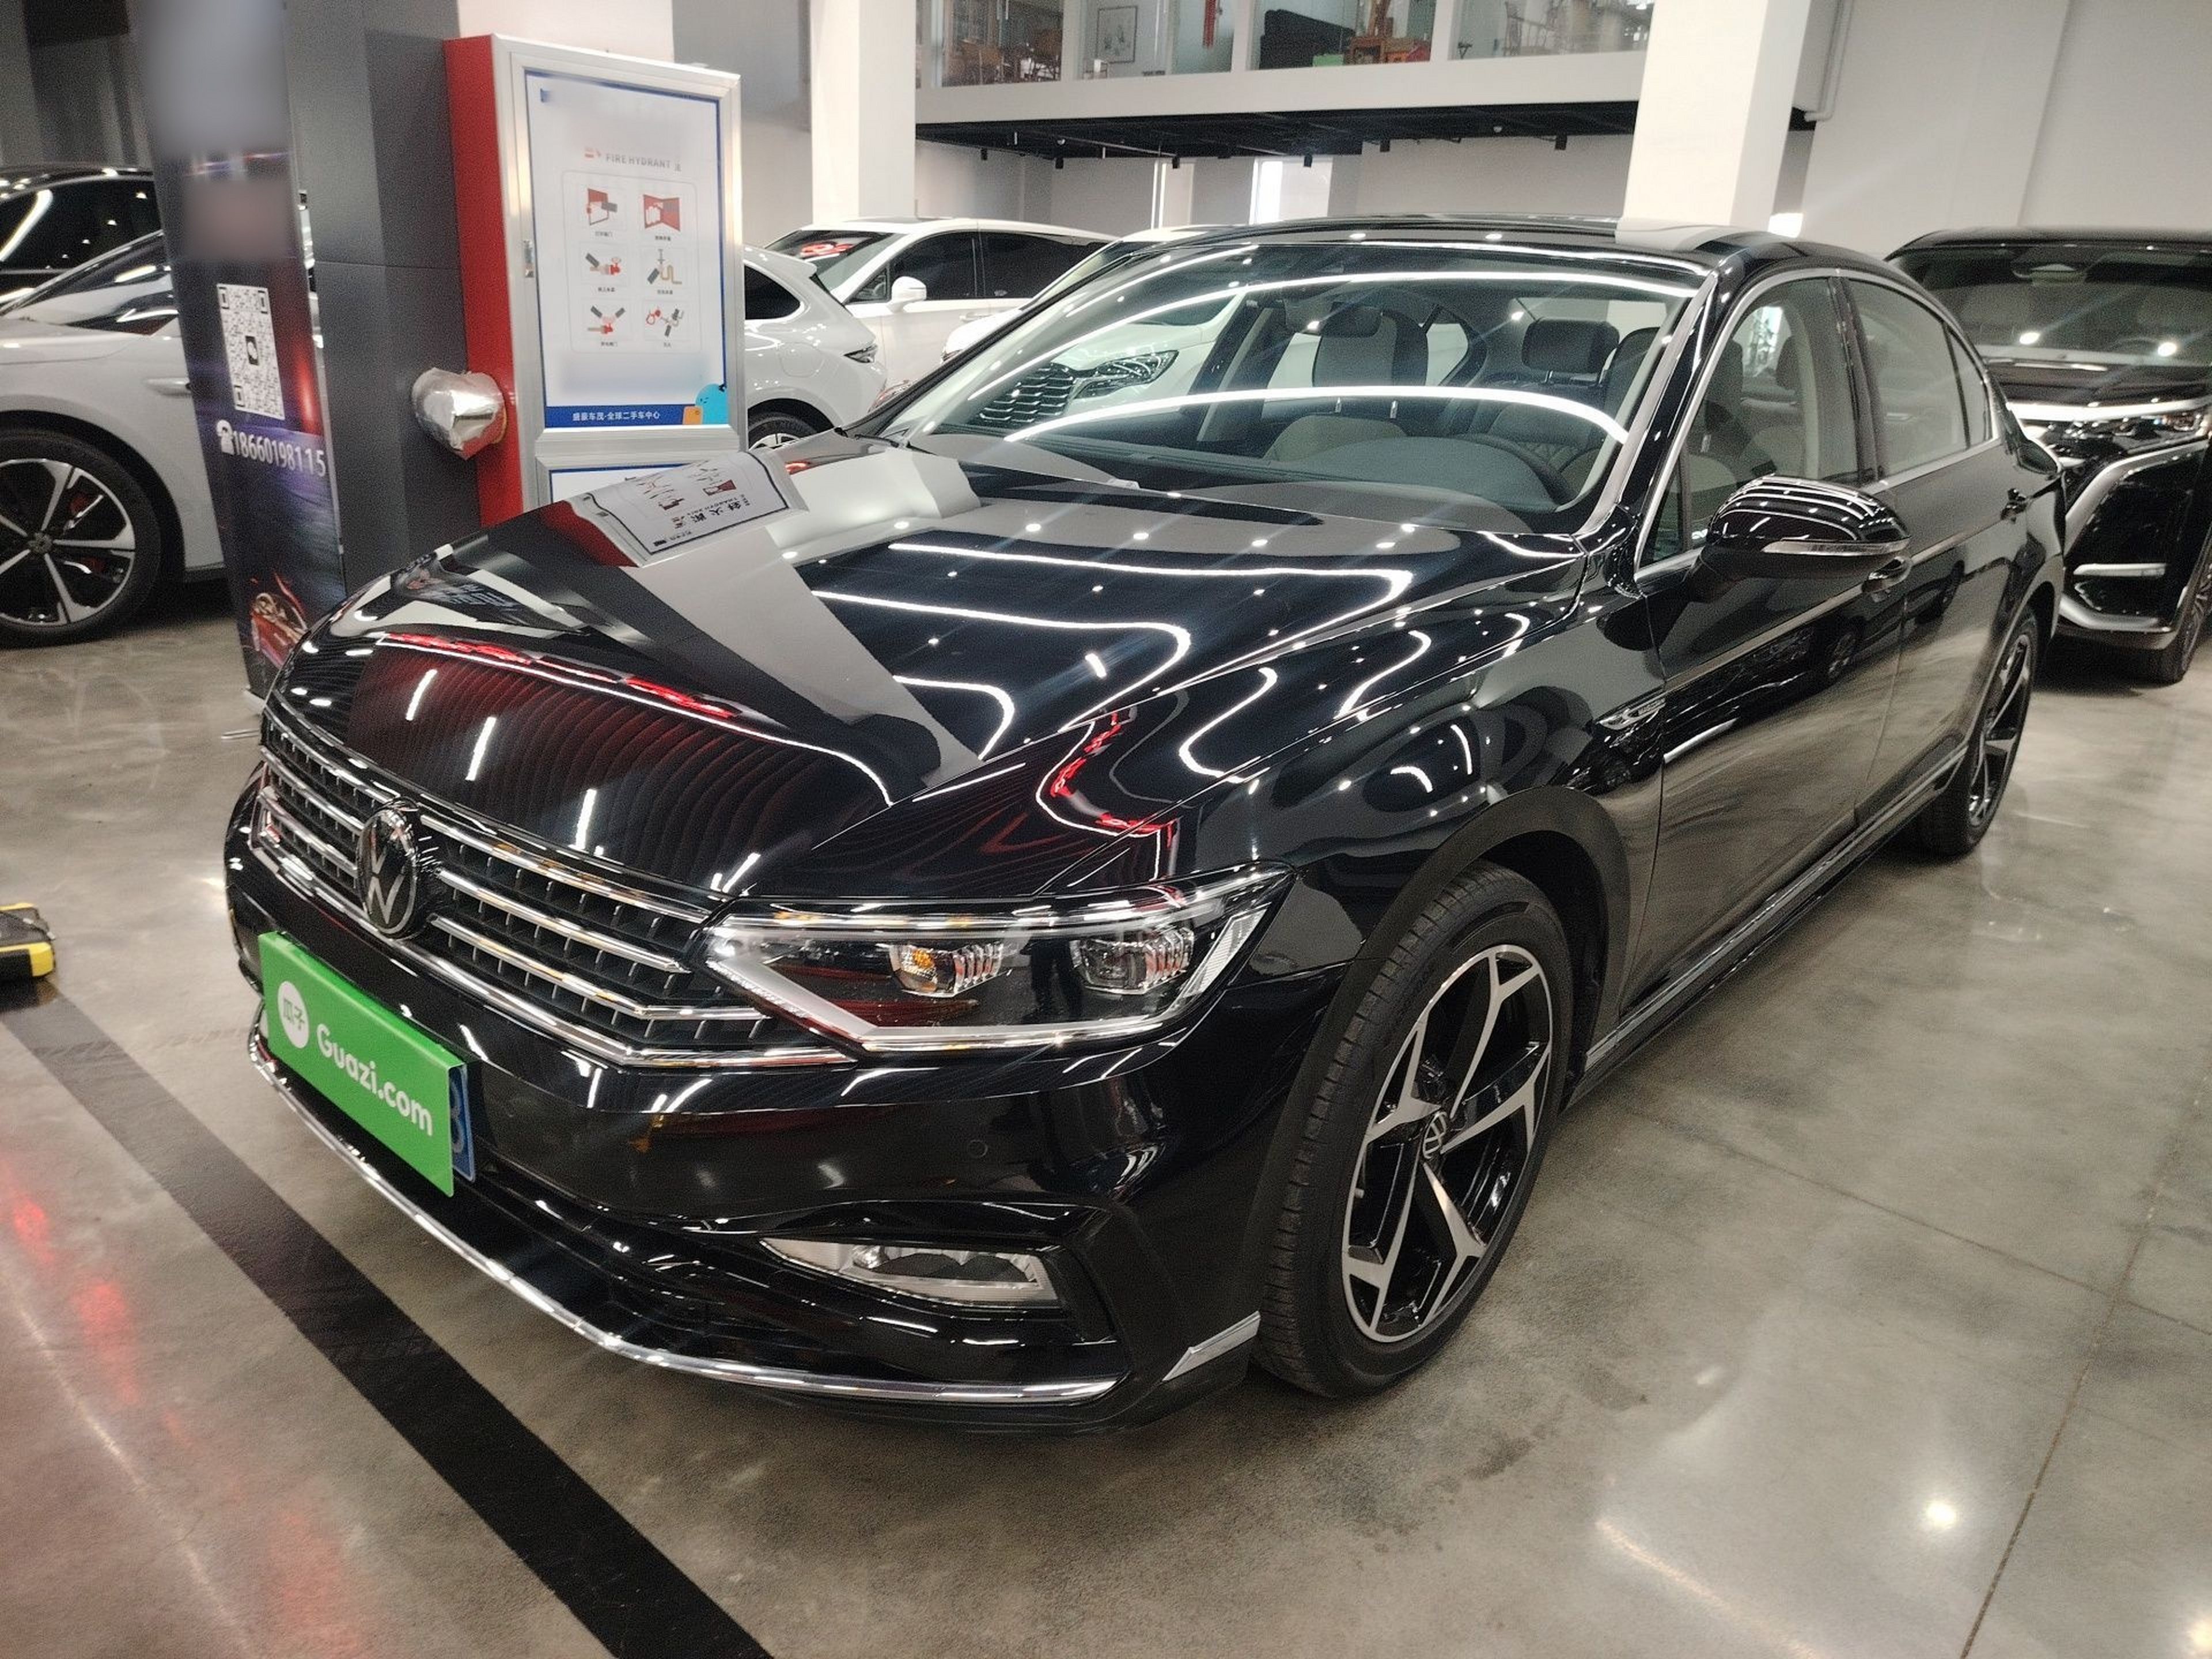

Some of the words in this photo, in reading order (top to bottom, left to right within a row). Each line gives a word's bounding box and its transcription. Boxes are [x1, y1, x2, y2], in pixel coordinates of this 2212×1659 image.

[606, 153, 627, 164] FIRE
[629, 157, 671, 168] HYDRANT
[233, 431, 326, 477] 18660198115
[317, 1023, 433, 1137] Guazi.com
